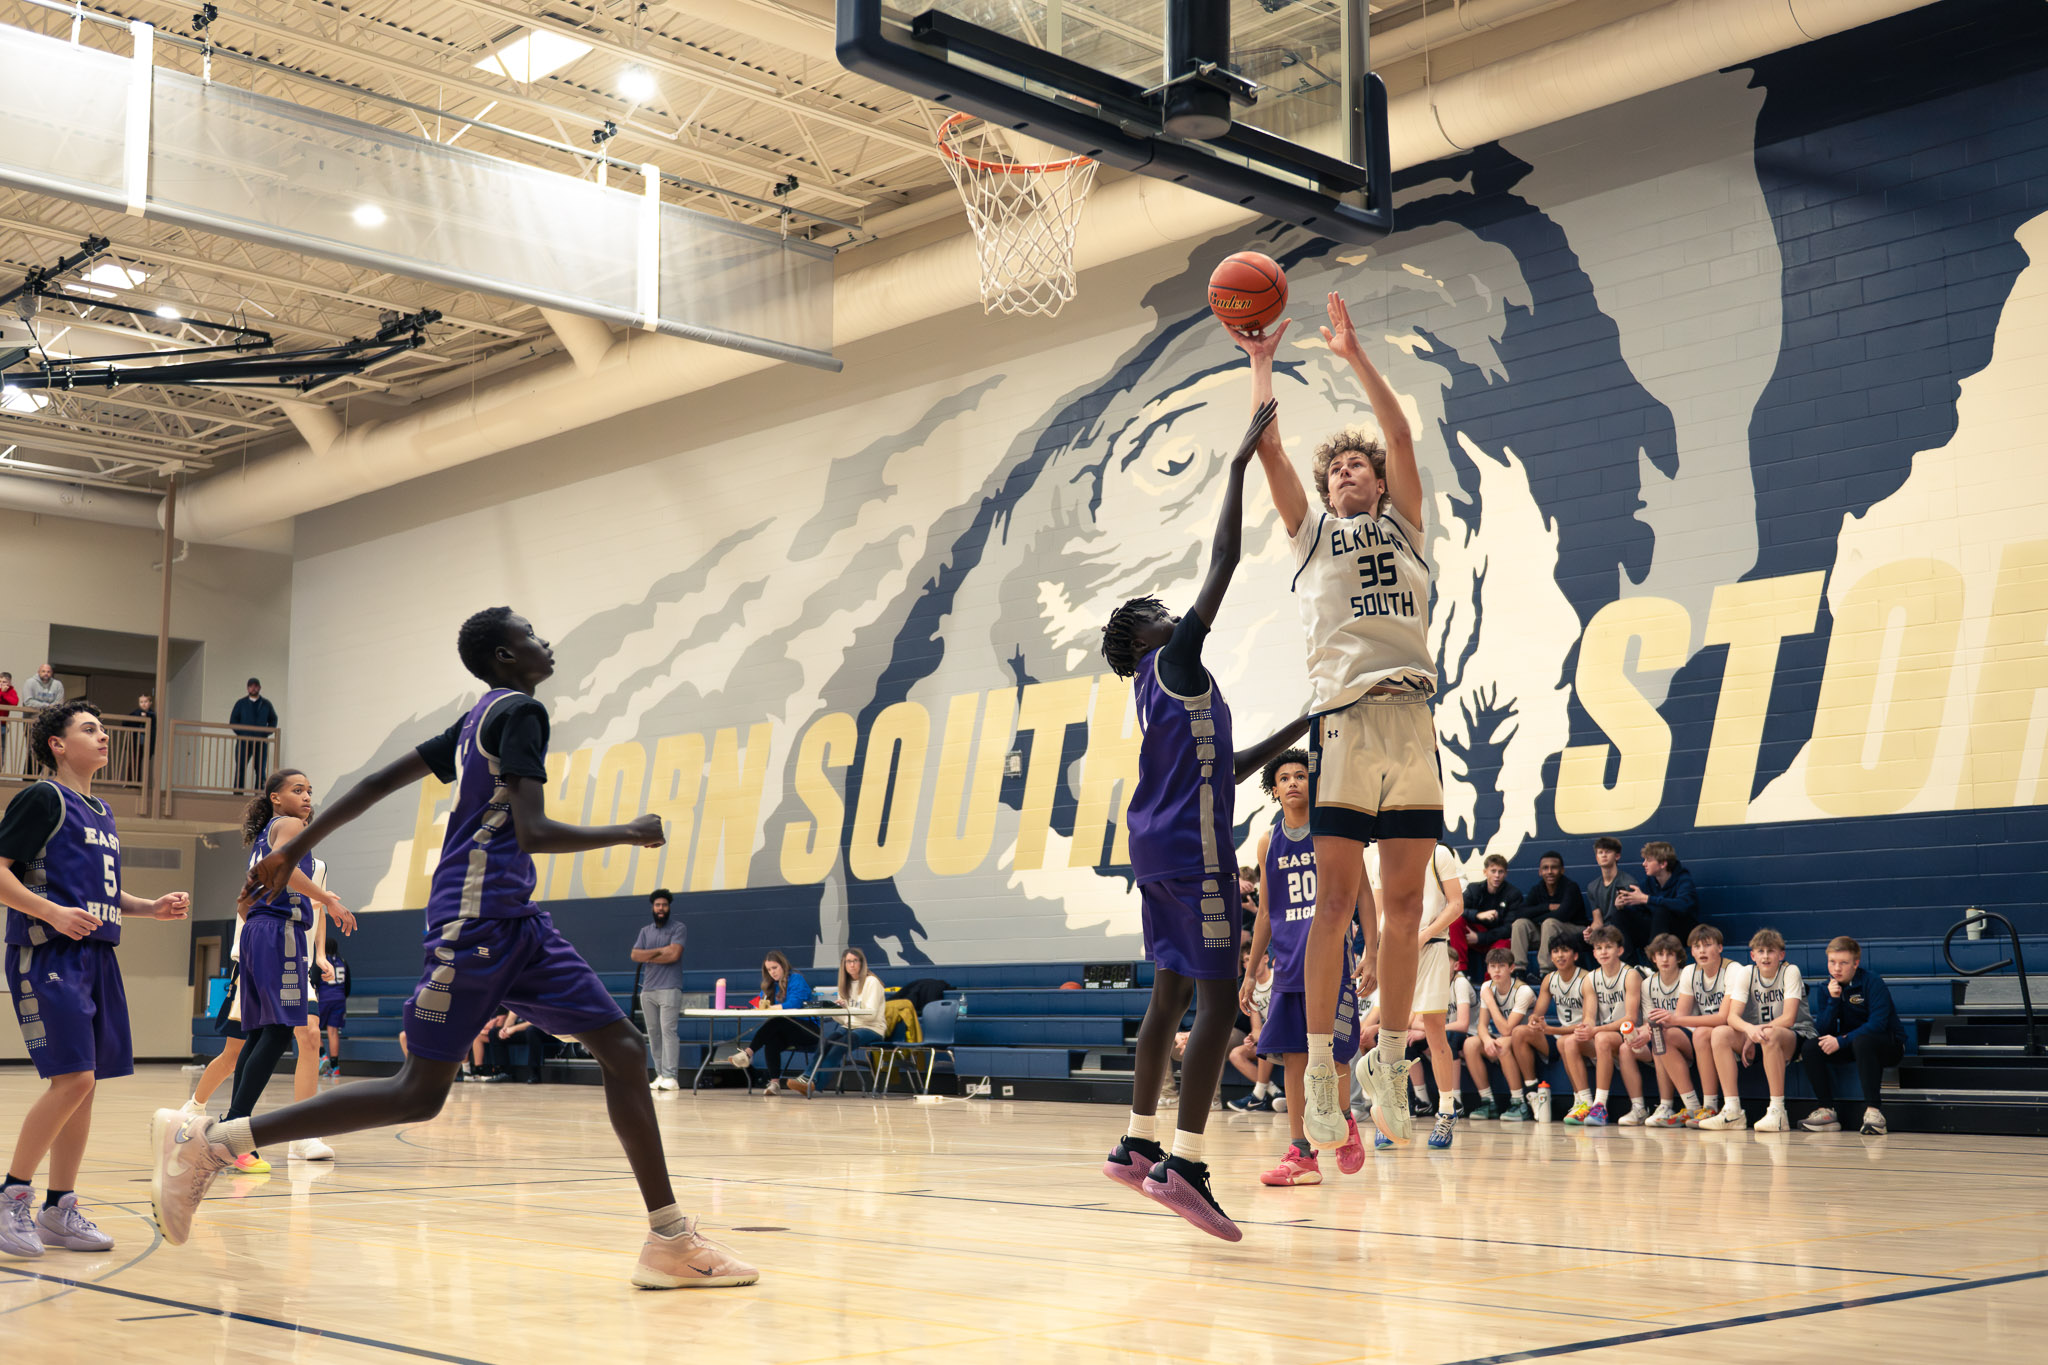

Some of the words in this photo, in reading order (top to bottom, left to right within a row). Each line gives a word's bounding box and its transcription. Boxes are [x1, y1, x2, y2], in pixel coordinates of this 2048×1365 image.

[1210, 291, 1252, 309] Baden
[1331, 522, 1404, 557] ELKHON
[1357, 551, 1398, 589] 35
[1350, 591, 1415, 618] SOUTH
[402, 722, 773, 910] EHORN
[779, 672, 1143, 886] SOUTH
[102, 853, 118, 898] 5
[1287, 870, 1317, 904] 20
[1564, 1009, 1572, 1023] 3
